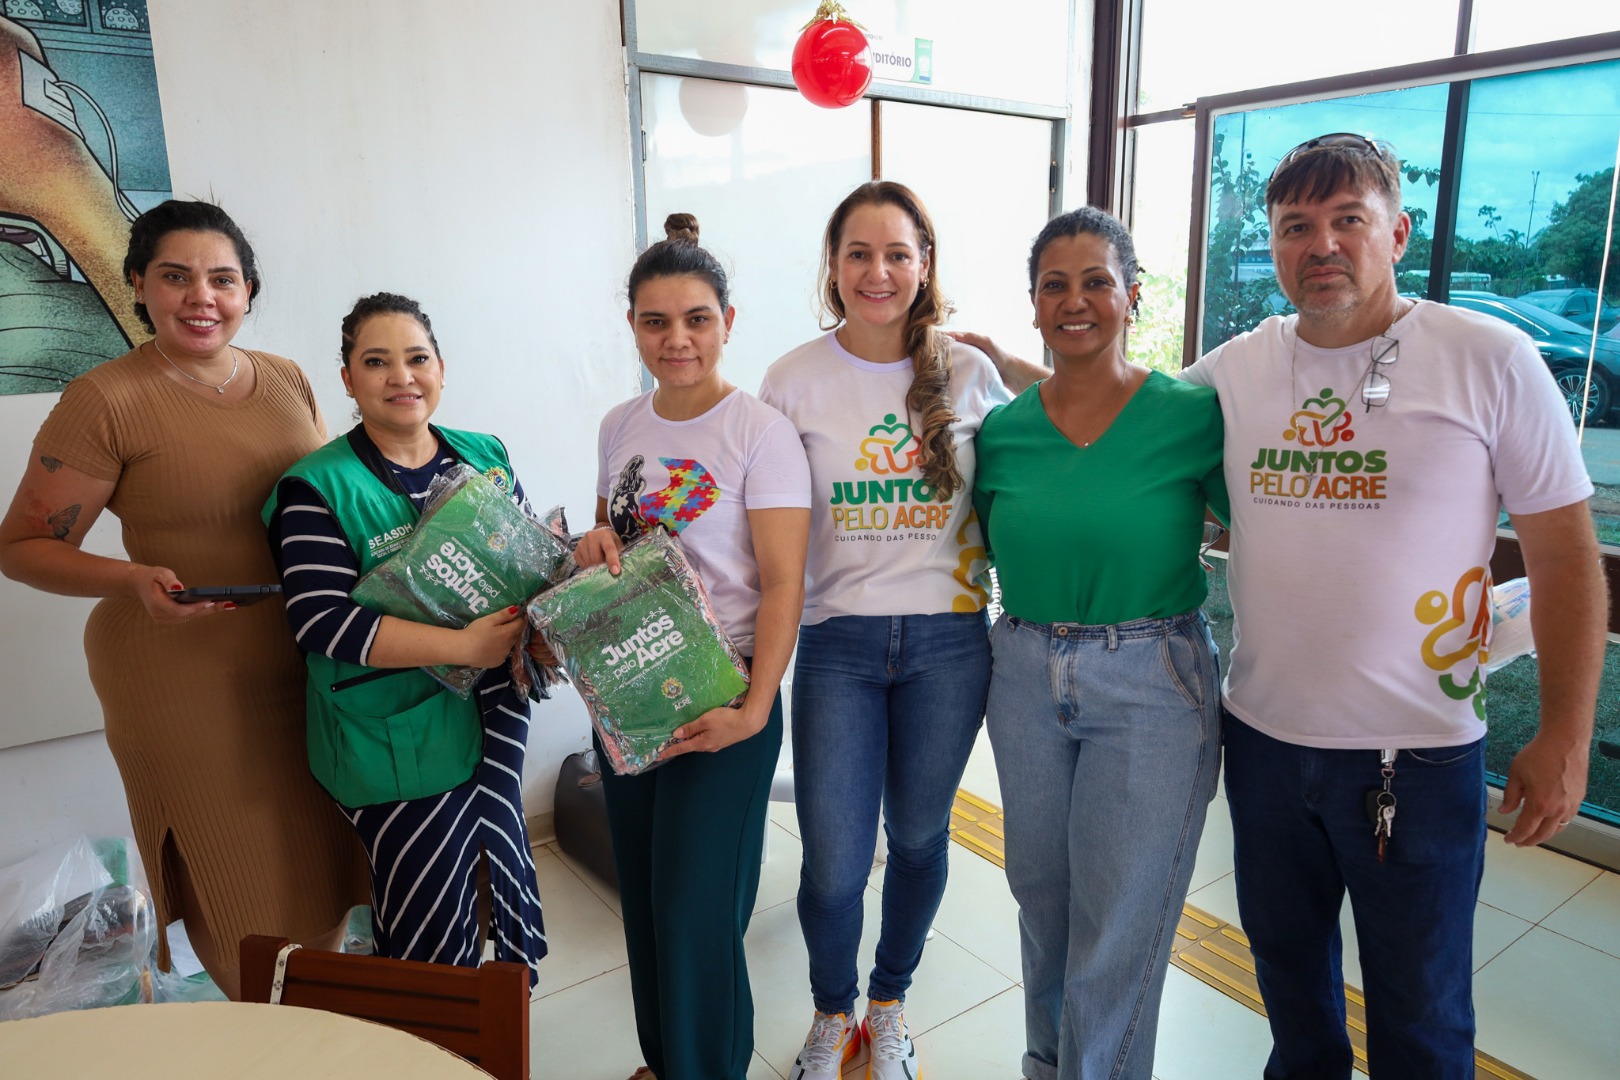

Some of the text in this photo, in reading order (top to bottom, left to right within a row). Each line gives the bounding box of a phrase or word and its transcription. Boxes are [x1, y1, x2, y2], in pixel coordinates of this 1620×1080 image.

[873, 52, 912, 67] DITÓRIO
[1250, 448, 1387, 473] JUNTOS
[830, 478, 953, 504] JUNTO
[1250, 471, 1387, 499] PELO ACRE
[1253, 497, 1301, 508] CUIDANDO
[1330, 502, 1380, 510] PESSOAS
[831, 506, 889, 531] PELO
[368, 523, 414, 549] SEASDH
[834, 532, 938, 542] CUIDANDO DAS PESSO
[440, 542, 485, 583] Acre
[426, 554, 490, 615] Juntos
[478, 579, 500, 598] pelo
[601, 615, 674, 666] Juntos
[613, 659, 637, 680] pelo
[636, 630, 684, 669] Acre
[673, 696, 693, 711] ACRE
